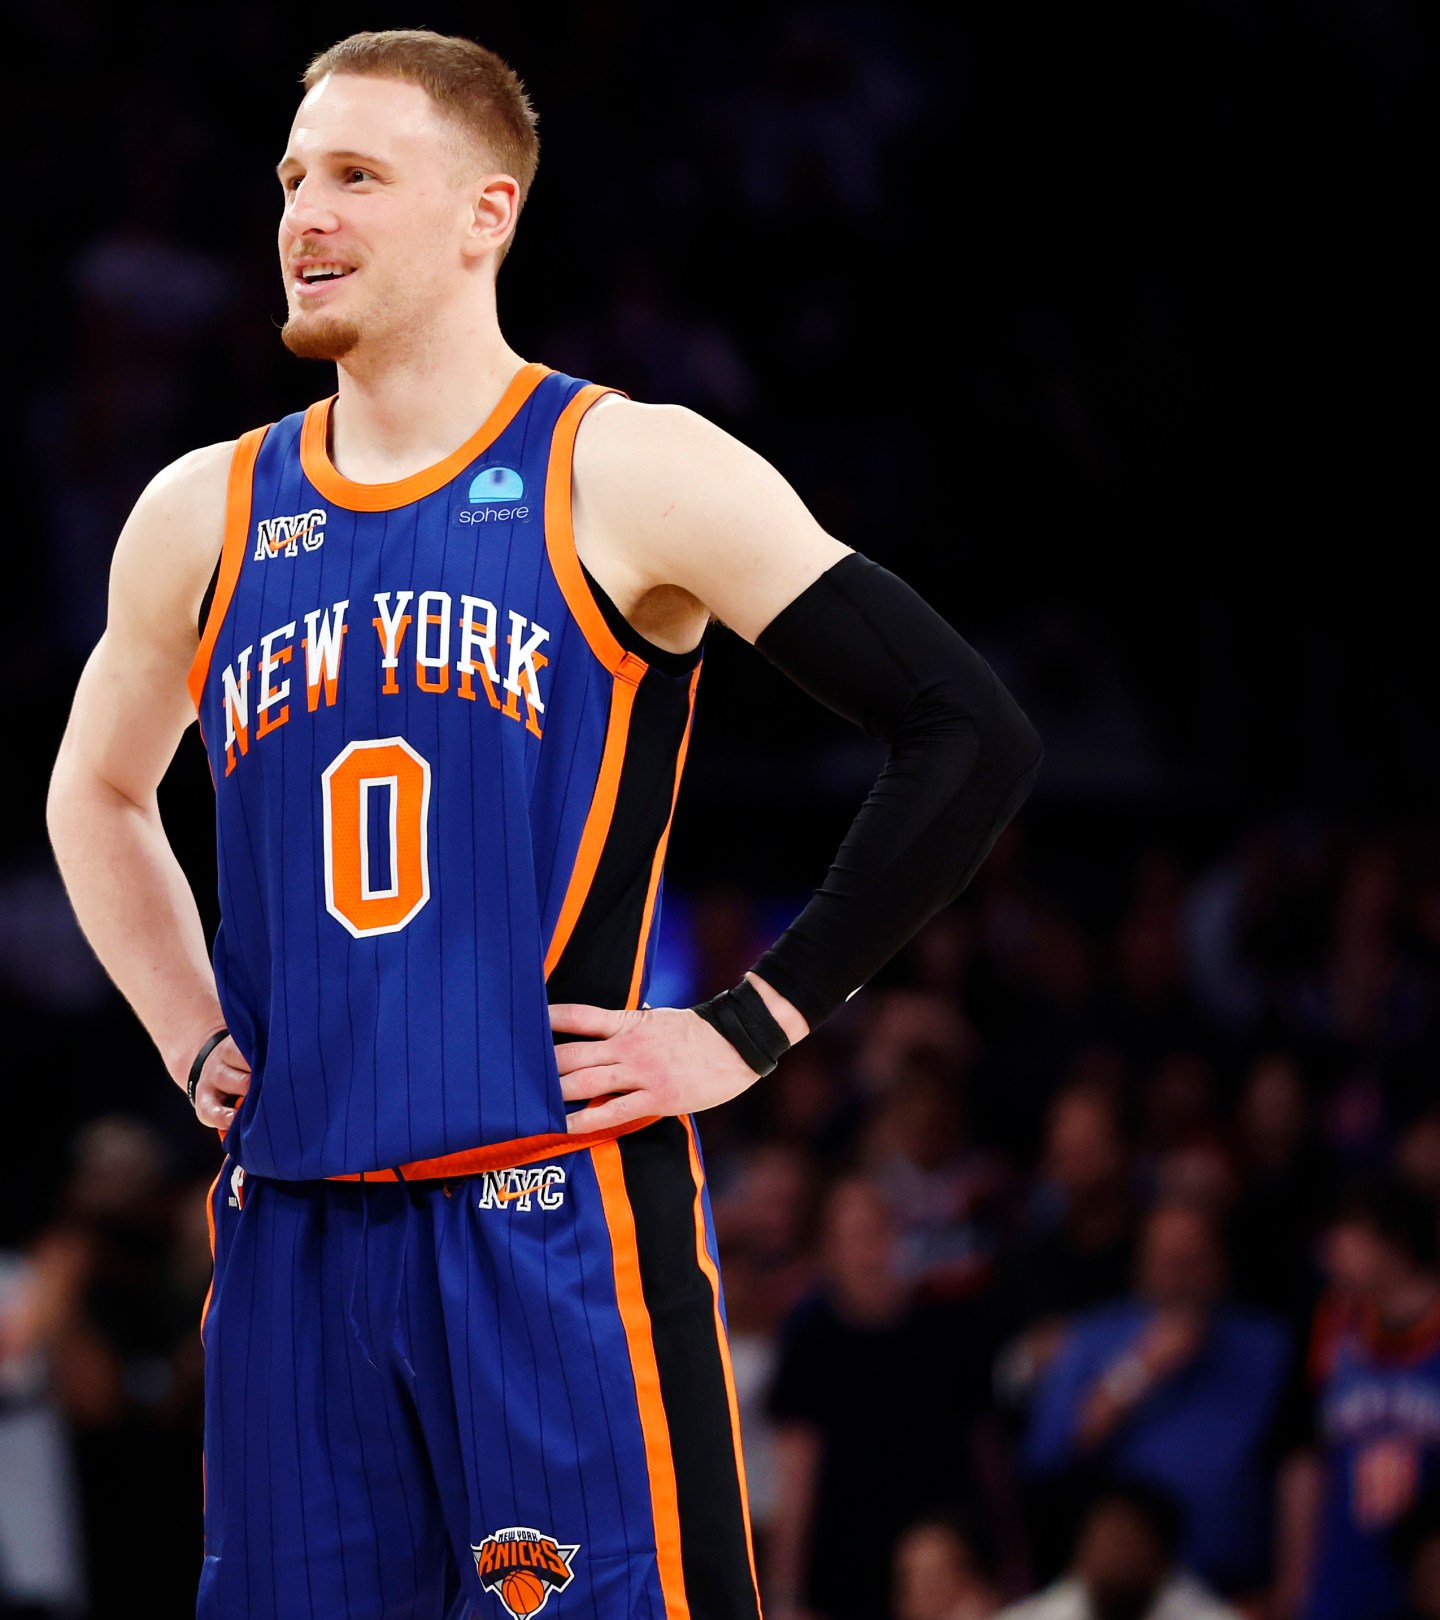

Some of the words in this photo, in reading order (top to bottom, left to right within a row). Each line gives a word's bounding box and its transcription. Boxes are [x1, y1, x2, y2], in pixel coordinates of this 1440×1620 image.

[254, 509, 327, 561] NYC
[459, 503, 530, 527] sphere
[222, 600, 349, 751] NEW
[373, 590, 550, 714] YORK
[321, 736, 431, 939] 0
[479, 1166, 565, 1211] NYC
[478, 1539, 570, 1578] KNICKS
[498, 1531, 516, 1542] NEW
[517, 1530, 538, 1541] YORK
